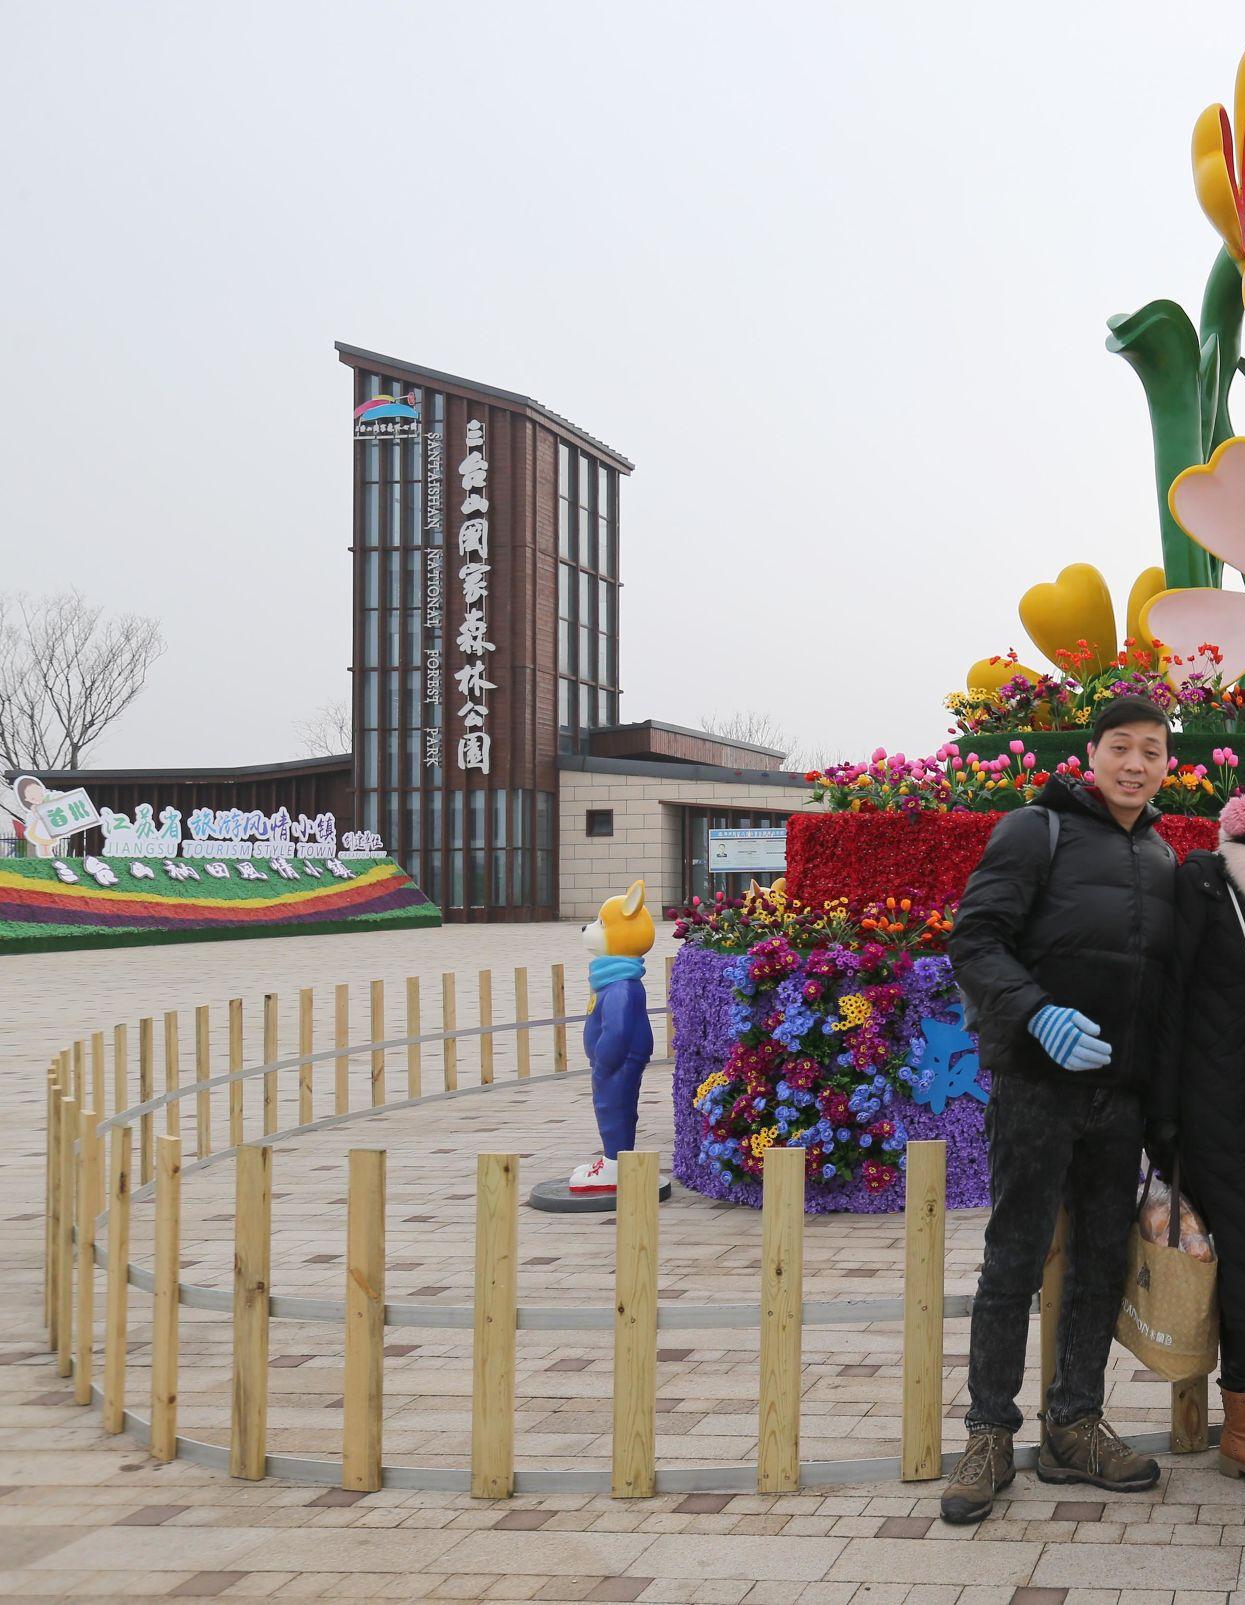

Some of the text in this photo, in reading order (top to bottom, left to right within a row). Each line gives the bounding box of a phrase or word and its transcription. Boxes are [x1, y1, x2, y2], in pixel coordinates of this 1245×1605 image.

[425, 431, 442, 769] SANTAISHAN NATIONAL FOREST PARK
[105, 842, 335, 857] JIANGSU TOURISM STYLE TOWN
